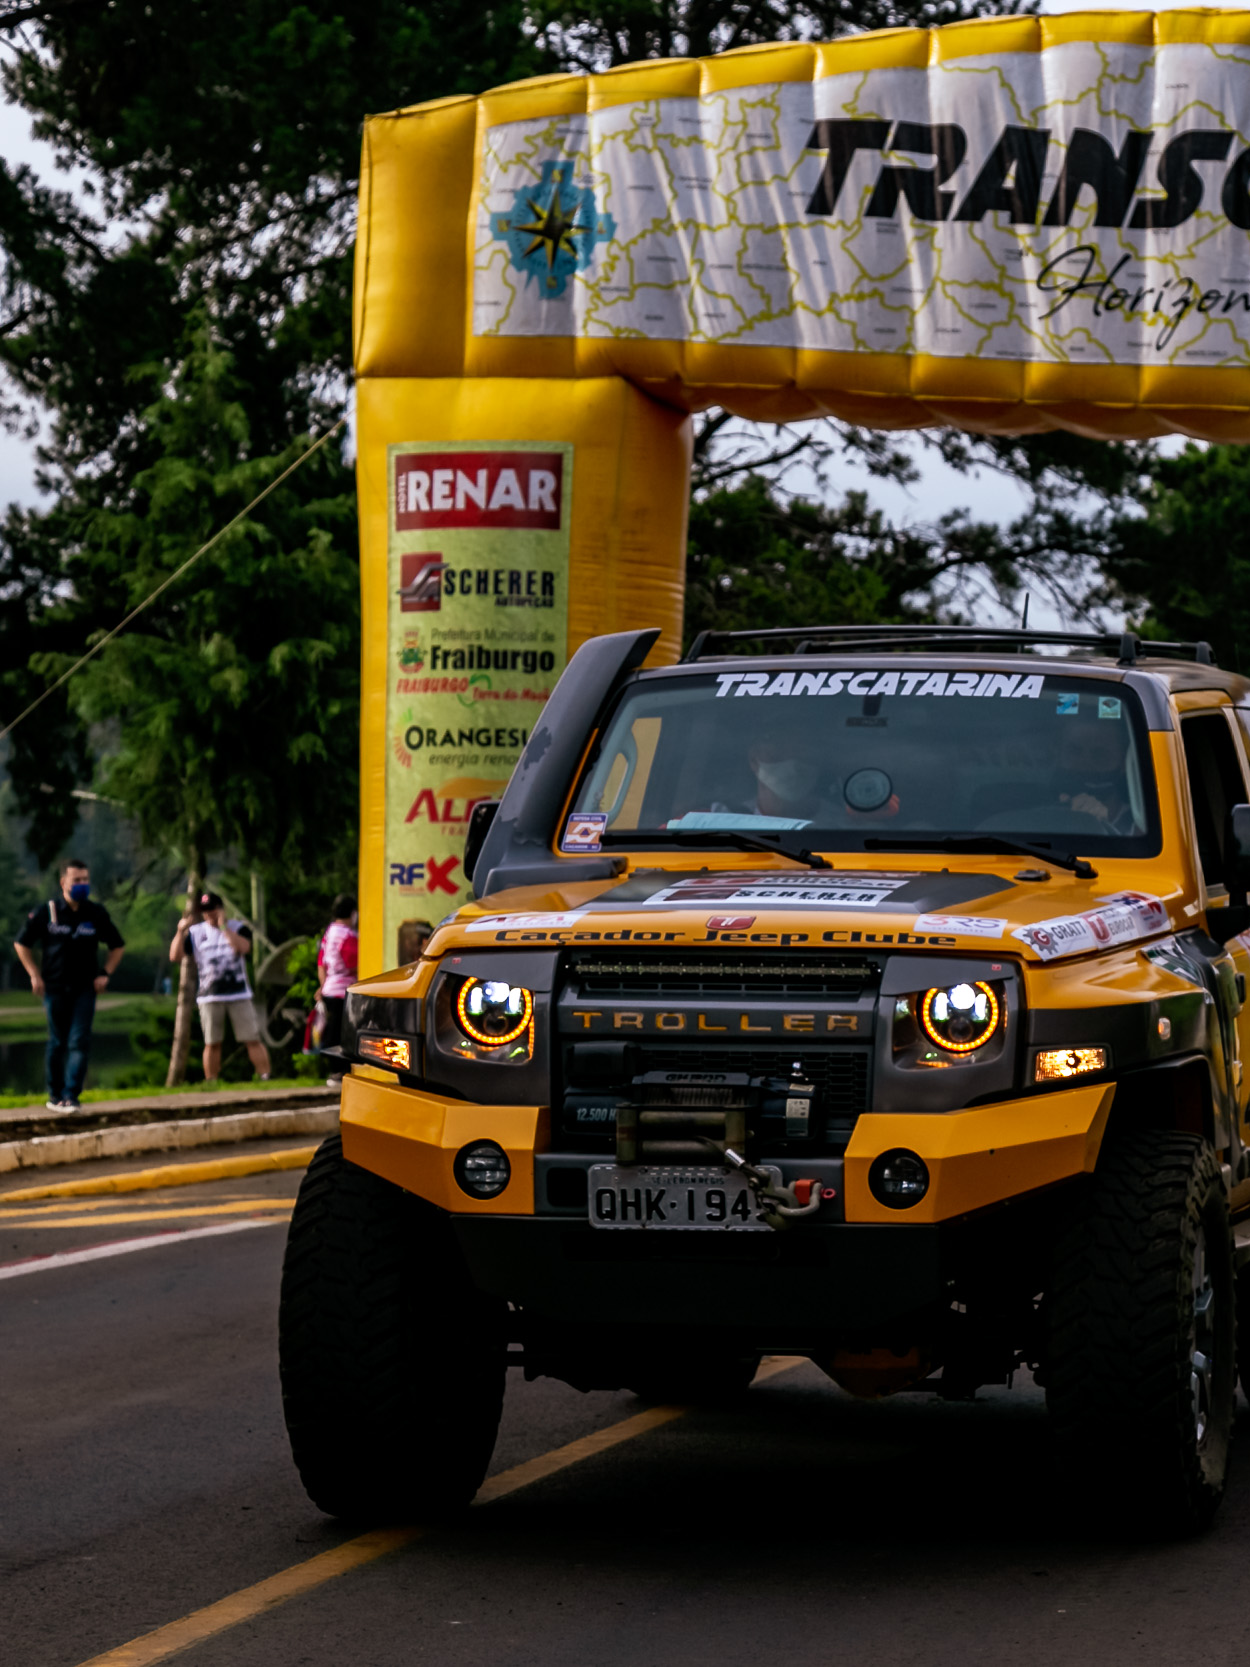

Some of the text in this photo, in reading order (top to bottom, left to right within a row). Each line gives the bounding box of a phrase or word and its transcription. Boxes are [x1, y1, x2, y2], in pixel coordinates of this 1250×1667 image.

[407, 468, 557, 513] RENAR
[444, 568, 555, 597] SCHERER
[431, 628, 555, 643] Prefeitura Municipal de
[431, 645, 555, 673] Fraiburgo
[396, 676, 469, 694] FRAIBURGO
[715, 671, 1045, 699] TRANSCATARINA
[429, 752, 480, 768] energia
[495, 929, 686, 947] Caçador
[693, 930, 810, 946] Jeep
[822, 930, 956, 946] Clube
[573, 1011, 858, 1032] TROLLER
